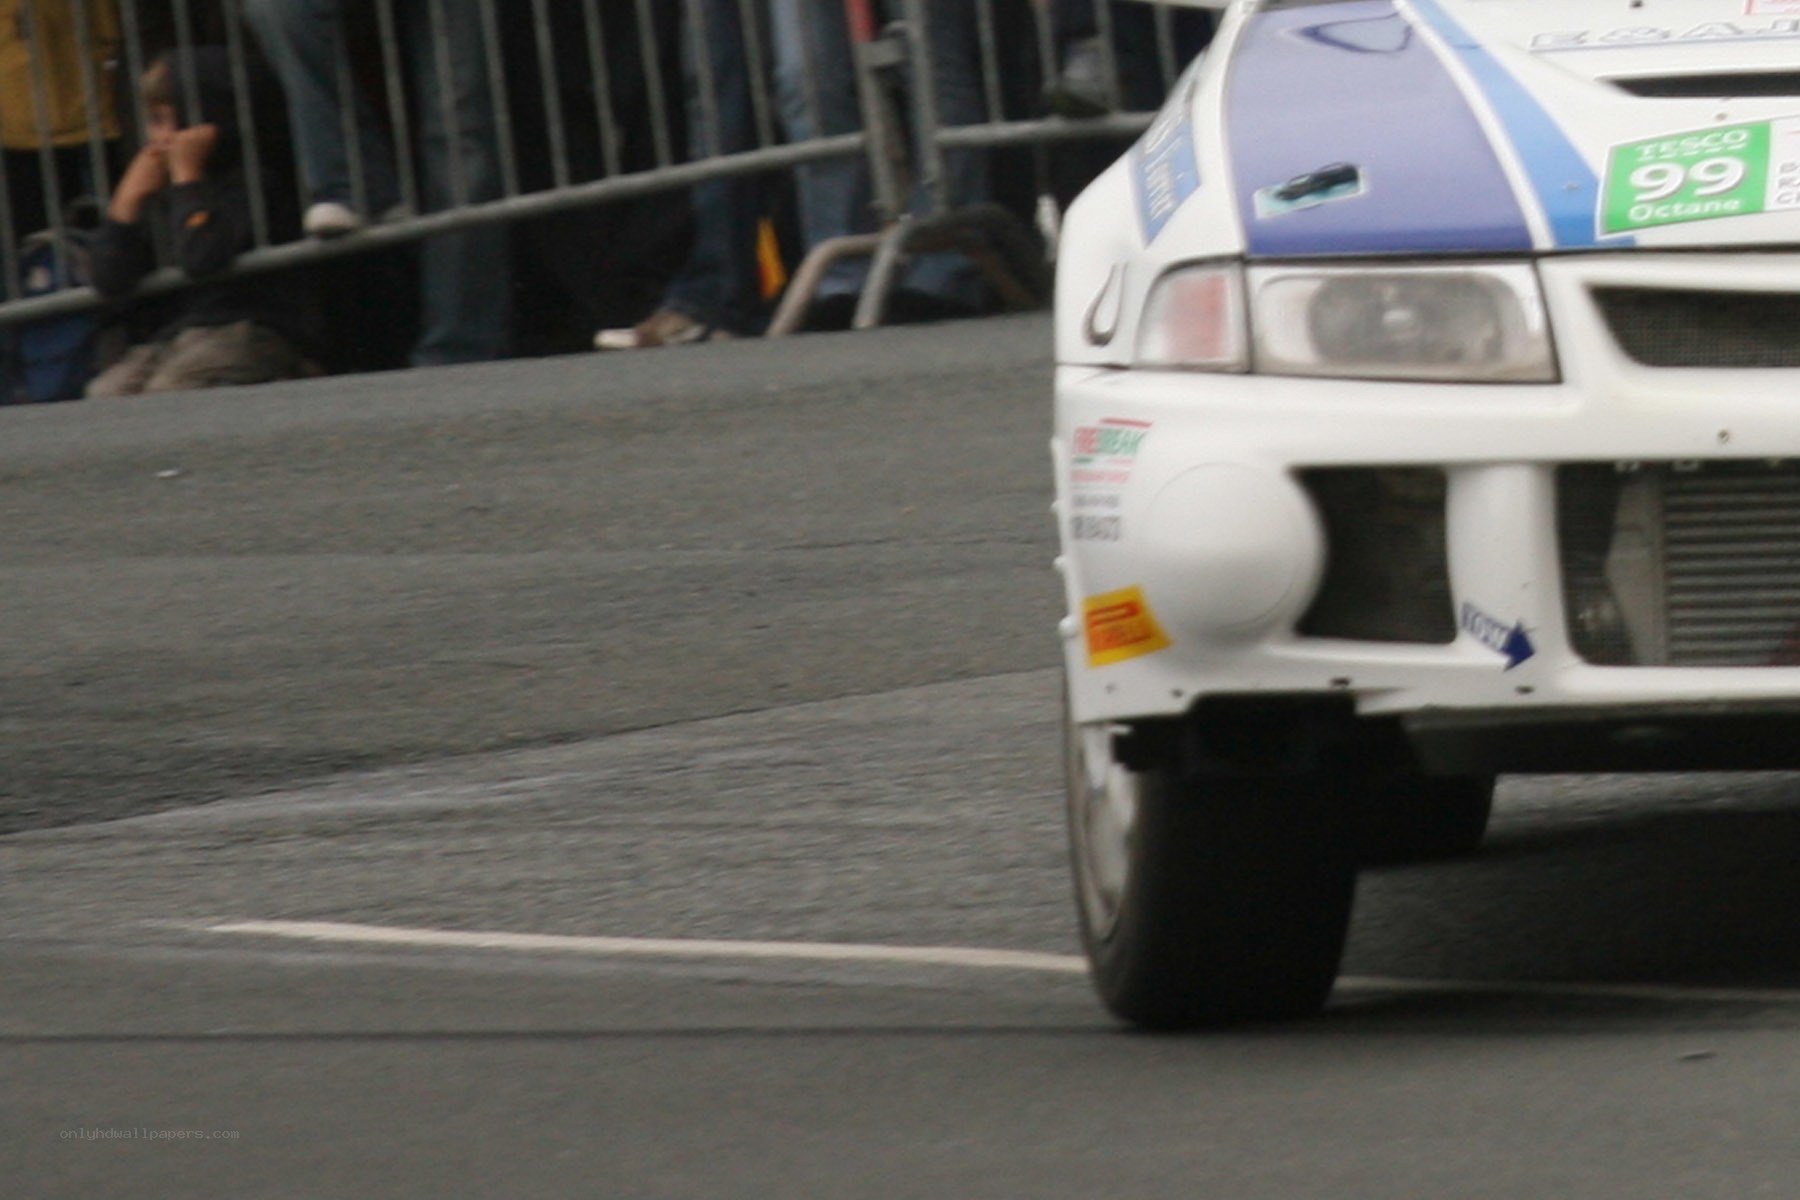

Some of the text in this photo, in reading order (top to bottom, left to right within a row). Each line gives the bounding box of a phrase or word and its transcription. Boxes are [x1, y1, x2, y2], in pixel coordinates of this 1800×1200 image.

[1636, 129, 1749, 158] TESCO
[1629, 155, 1747, 202] 99
[1628, 198, 1743, 223] Octane
